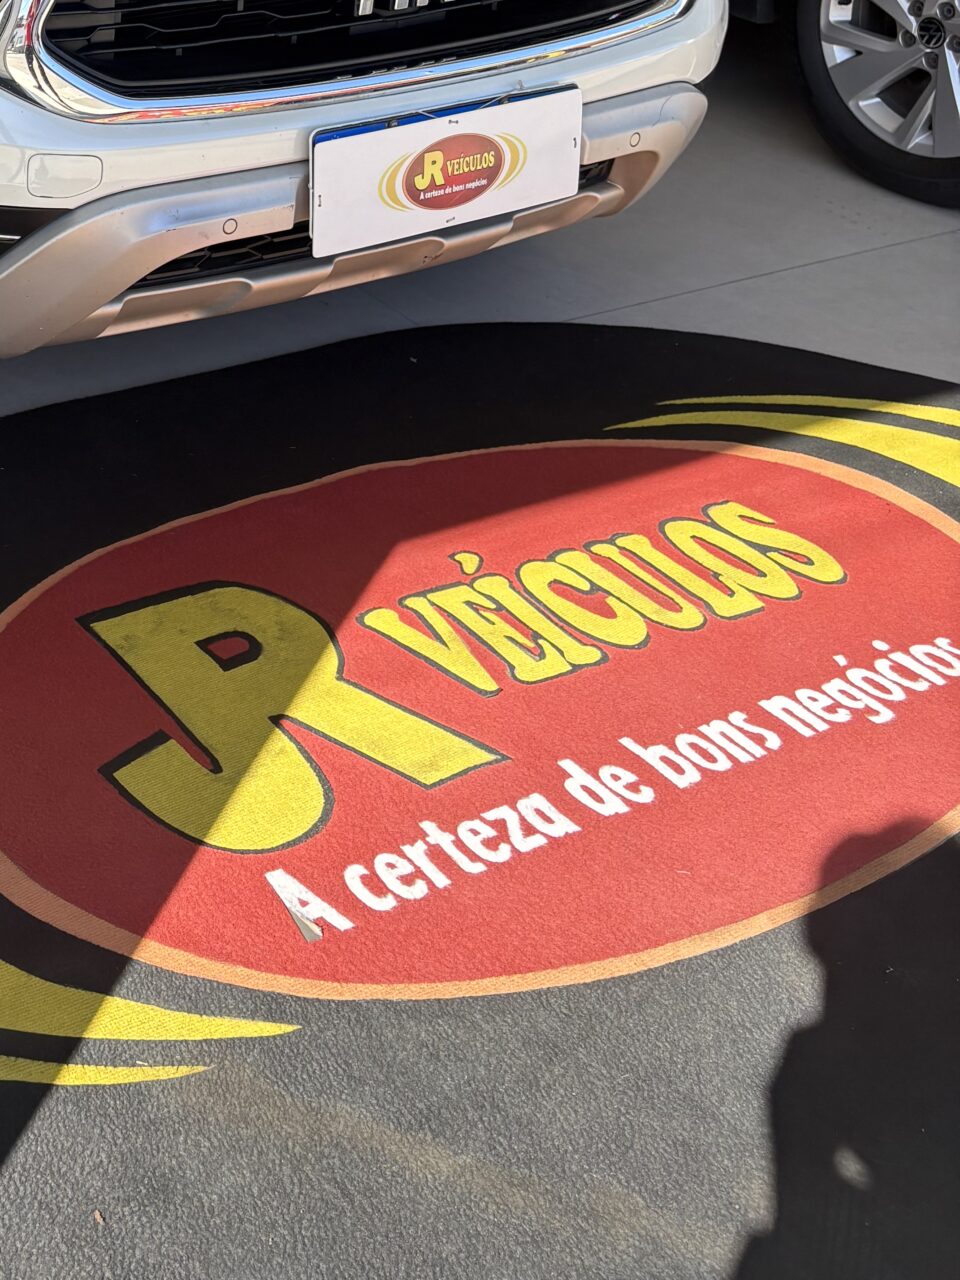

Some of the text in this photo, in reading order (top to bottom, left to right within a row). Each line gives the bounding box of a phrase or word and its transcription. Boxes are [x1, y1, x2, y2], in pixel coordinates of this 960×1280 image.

[414, 150, 495, 191] JR VEÍCULOS
[419, 177, 488, 200] A certeza de bons negócios
[76, 500, 848, 853] JR VEÍCULOS
[264, 868, 356, 943] A
[343, 792, 582, 911] certeza
[557, 759, 656, 817] de
[618, 736, 783, 789] bons
